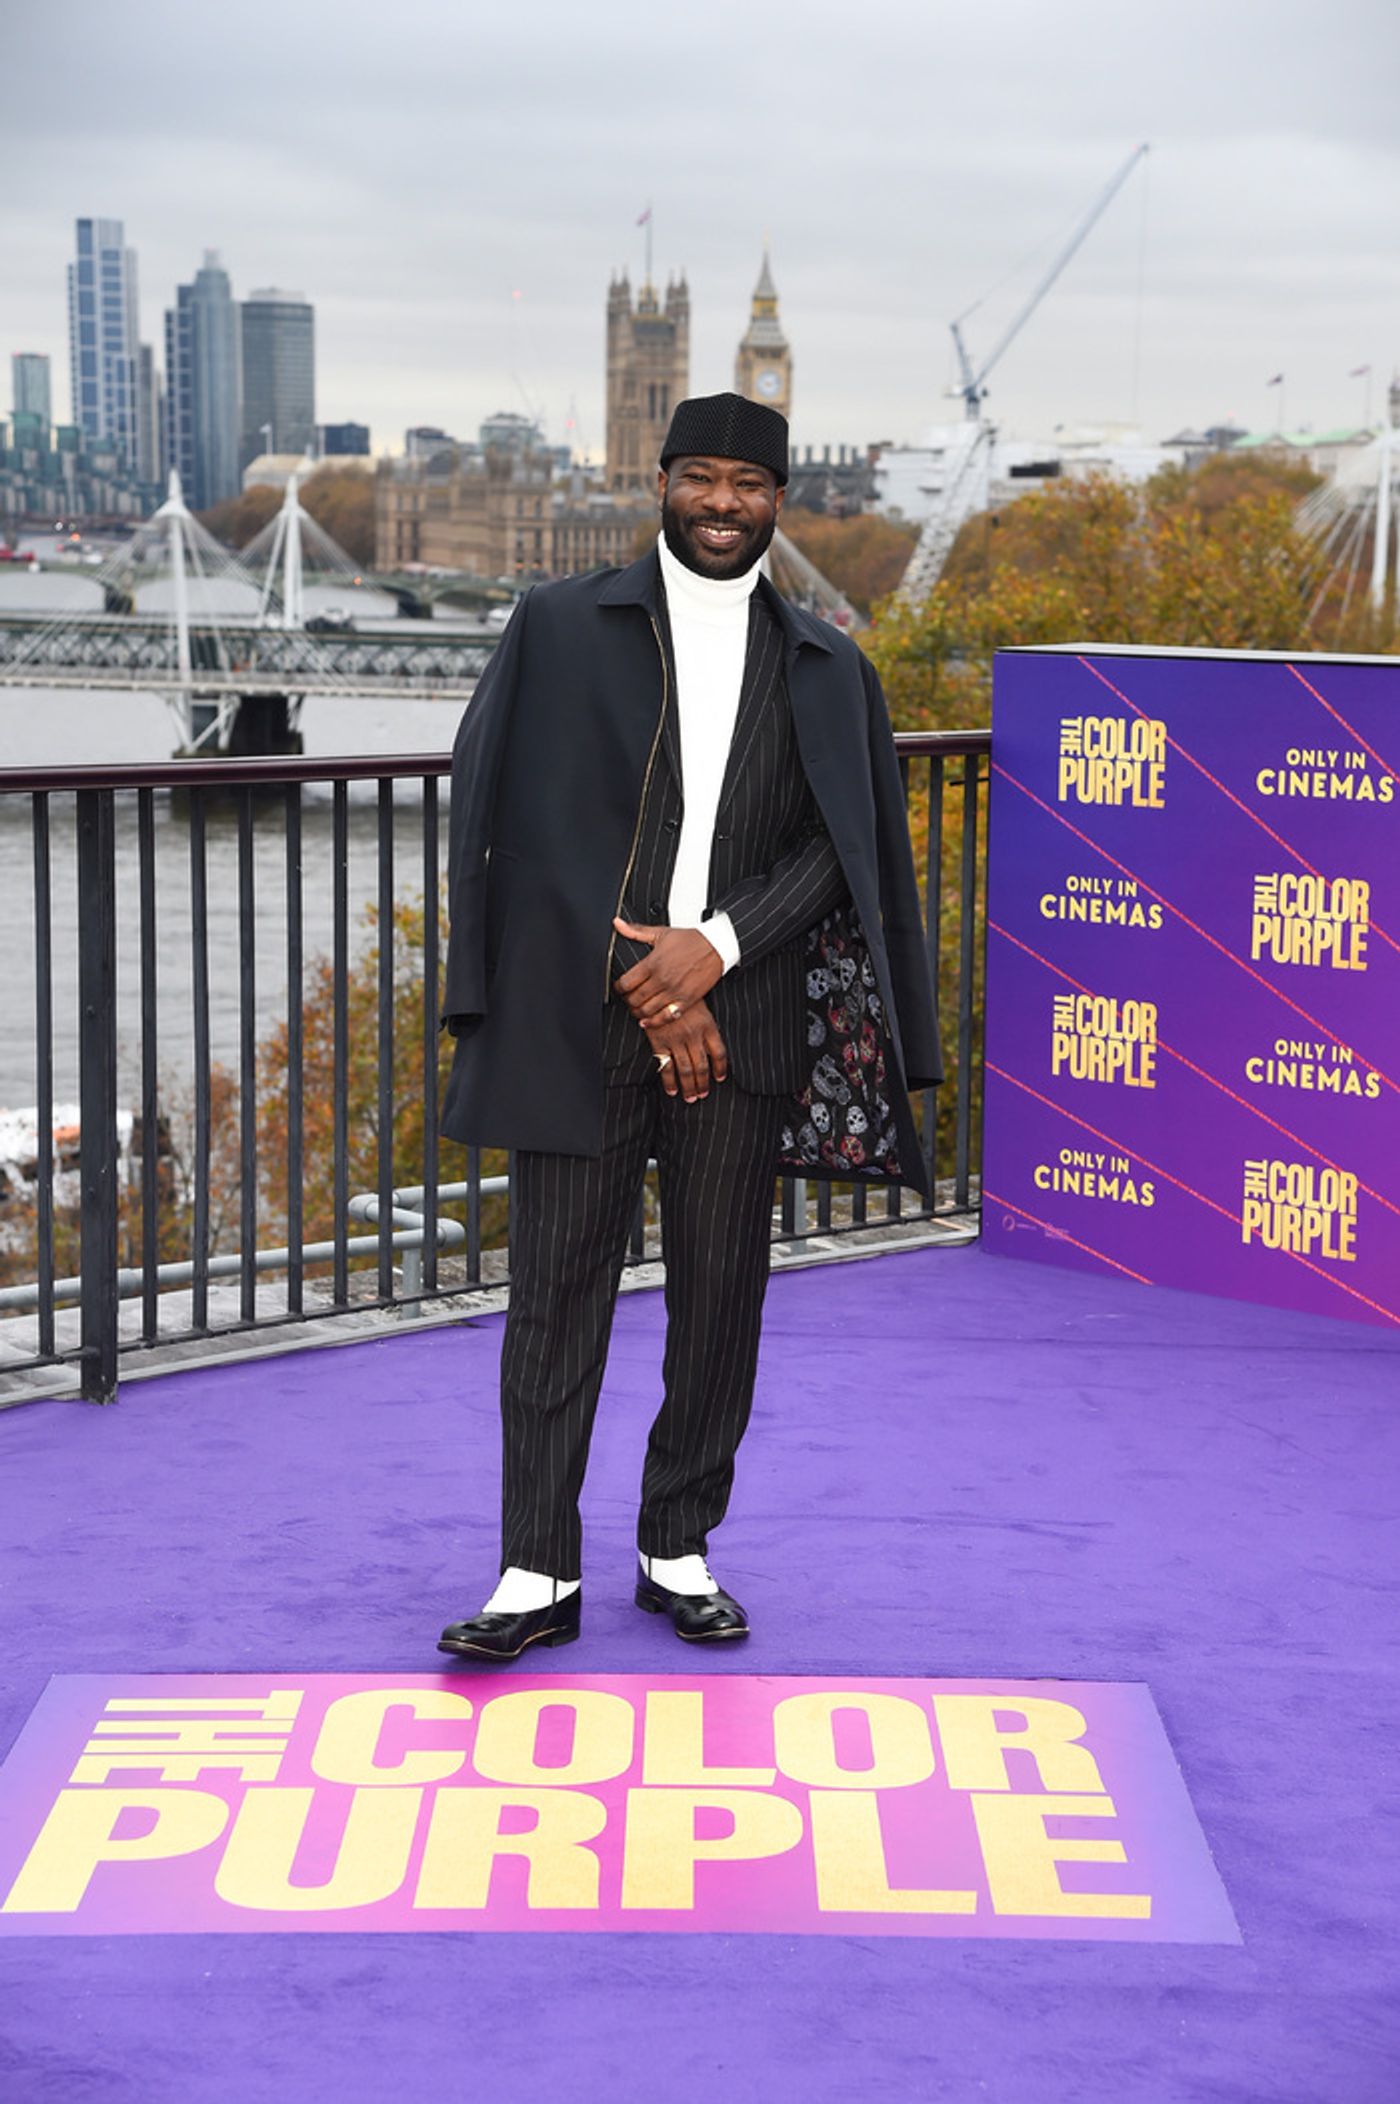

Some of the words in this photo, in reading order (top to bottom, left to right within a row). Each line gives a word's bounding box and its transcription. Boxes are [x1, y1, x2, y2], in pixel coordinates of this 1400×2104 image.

[1060, 717, 1082, 755] THE
[1083, 716, 1166, 762] COLOR
[1286, 749, 1338, 769] ONLY
[1345, 751, 1366, 769] IN
[1058, 757, 1165, 808] PURPLE
[1256, 769, 1395, 803] CINEMAS
[1066, 875, 1112, 896] ONLY
[1118, 880, 1137, 897] IN
[1254, 873, 1277, 913] THE
[1278, 873, 1370, 923] COLOR
[1039, 894, 1164, 929] CINEMAS
[1251, 914, 1368, 970] PURPLE
[1054, 994, 1074, 1032] THE
[1076, 994, 1157, 1043] COLOR
[1052, 1033, 1156, 1089] PURPLE
[1275, 1039, 1325, 1061] ONLY
[1332, 1045, 1352, 1064] IN
[1245, 1058, 1380, 1099] CINEMAS
[1059, 1148, 1105, 1170] ONLY
[1111, 1155, 1129, 1173] IN
[1034, 1165, 1155, 1207] CINEMAS
[1244, 1159, 1267, 1199] THE
[1268, 1161, 1357, 1215] COLOR
[1242, 1199, 1357, 1261] PURPLE
[69, 1690, 304, 1783] THE
[310, 1689, 1106, 1793] COLOR
[0, 1786, 1152, 1919] PURPLE
